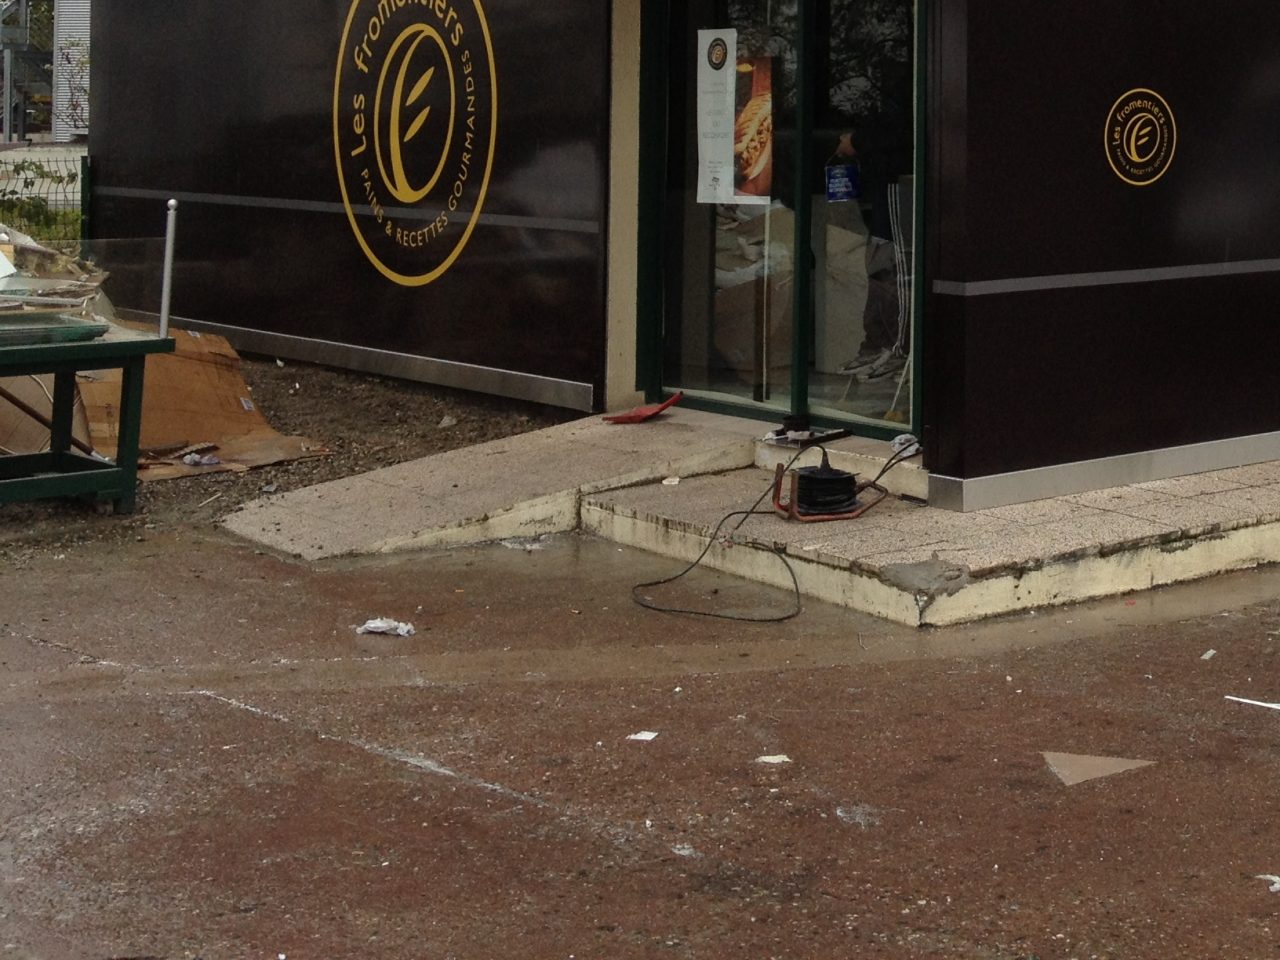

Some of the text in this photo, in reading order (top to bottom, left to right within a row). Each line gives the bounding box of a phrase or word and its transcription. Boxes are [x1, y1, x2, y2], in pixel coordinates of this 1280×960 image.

[361, 49, 476, 248] PAINS & RECETTES GOURMANDES
